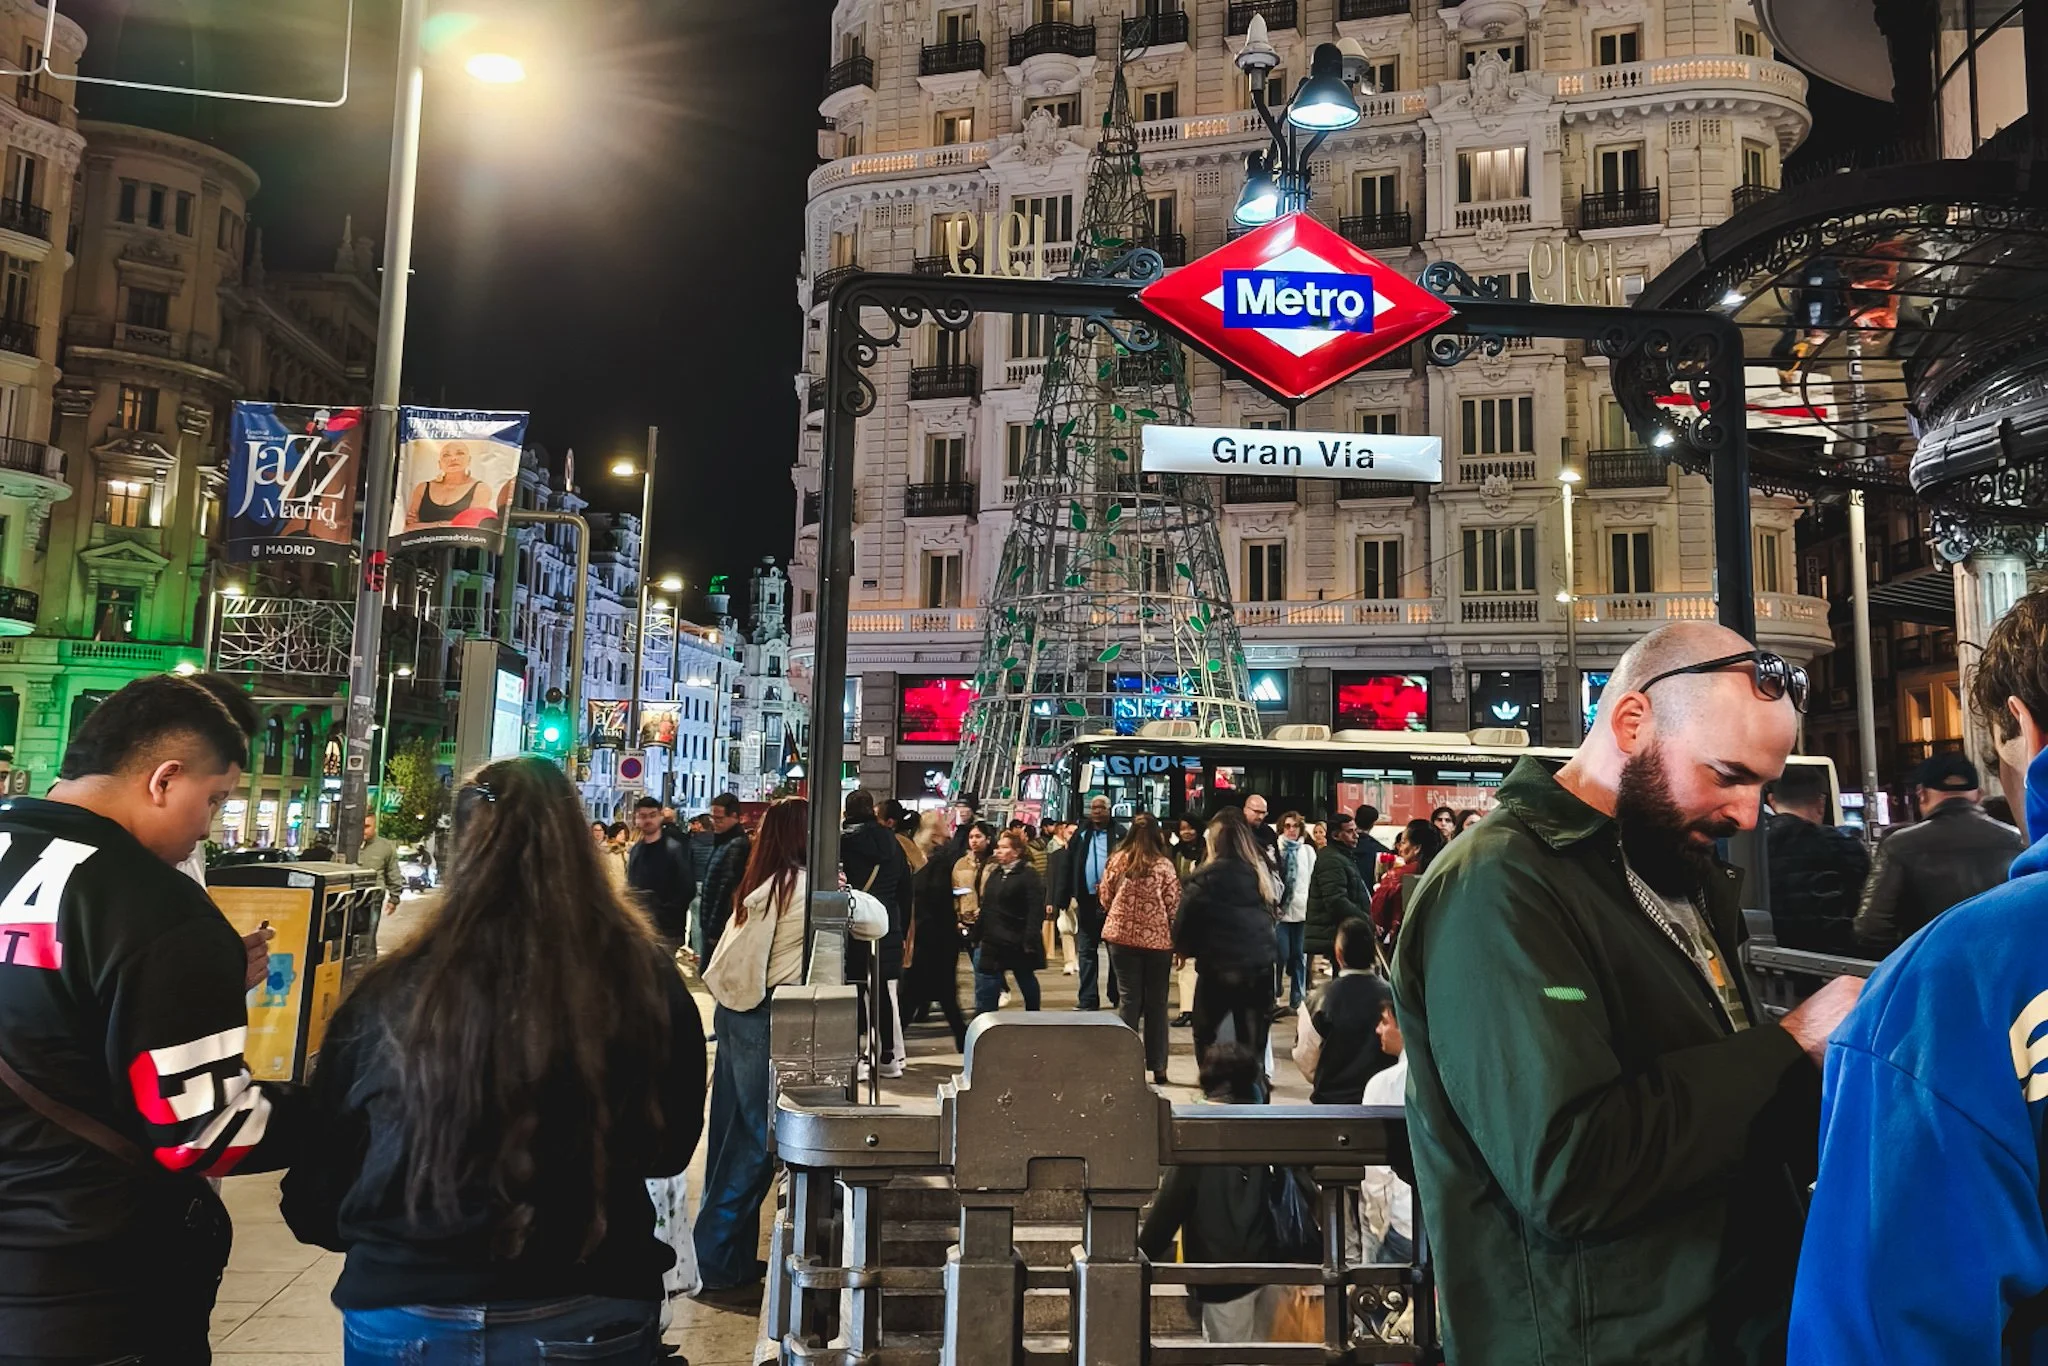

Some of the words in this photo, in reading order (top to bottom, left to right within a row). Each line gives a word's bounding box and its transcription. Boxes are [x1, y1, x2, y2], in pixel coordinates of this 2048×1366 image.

[1236, 278, 1365, 318] Metro
[1212, 436, 1302, 466] Gran
[1318, 440, 1374, 469] Vía
[260, 498, 337, 528] Madrid
[265, 545, 316, 556] MADRID
